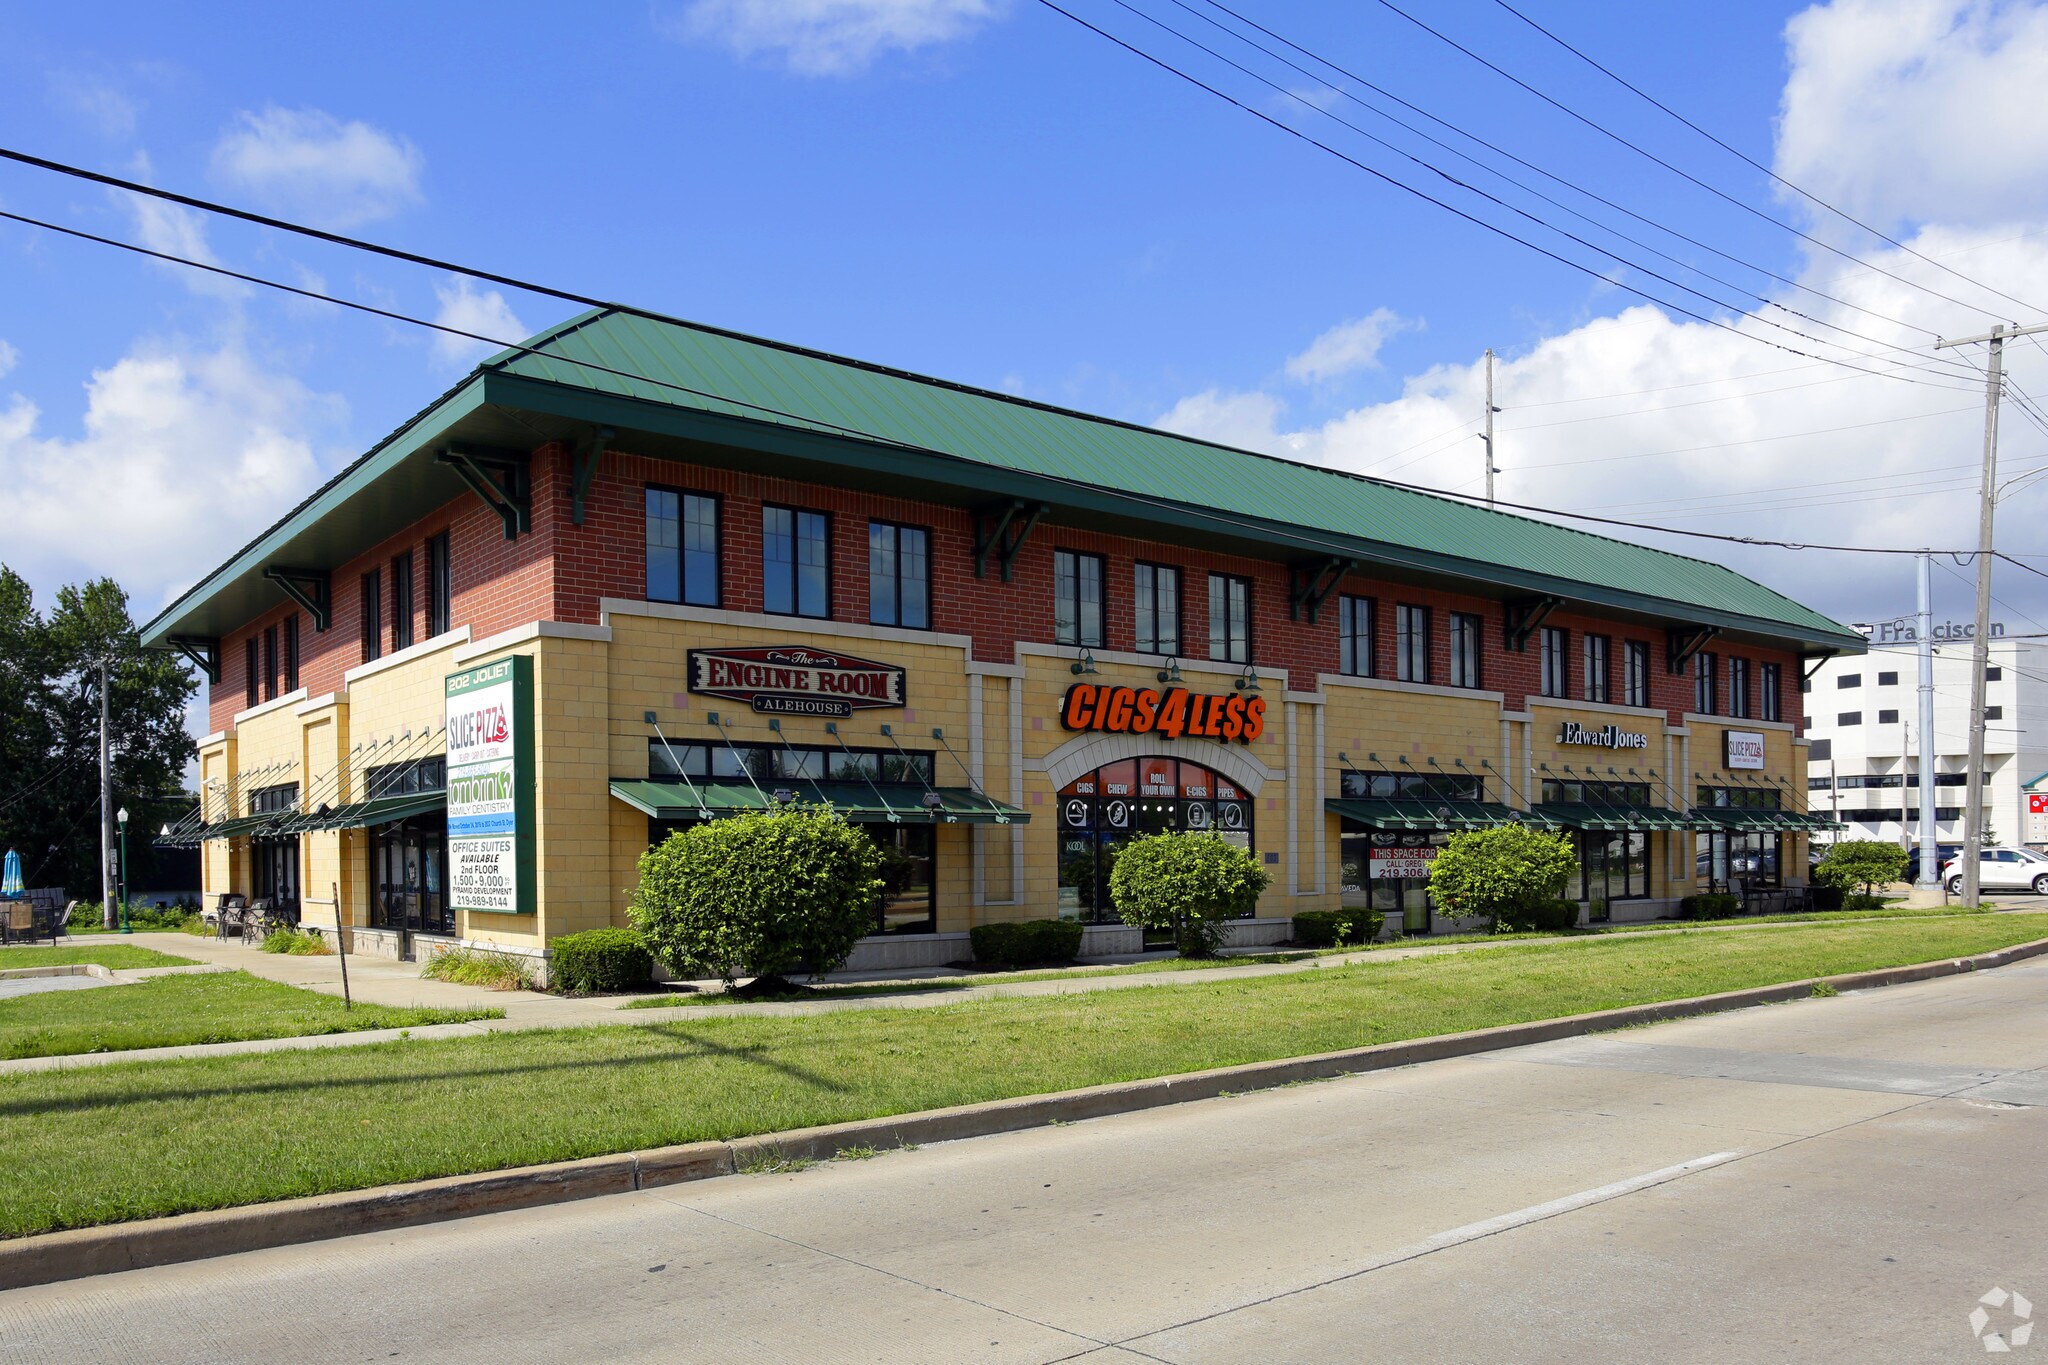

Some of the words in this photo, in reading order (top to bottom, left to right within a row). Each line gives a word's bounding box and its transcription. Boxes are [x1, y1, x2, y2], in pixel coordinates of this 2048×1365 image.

[1880, 621, 2005, 641] Fraciscn
[791, 652, 814, 665] The
[449, 675, 469, 691] 202
[473, 661, 510, 684] JOLIET
[707, 658, 809, 690] ENGINE
[817, 671, 889, 699] ROOM
[764, 699, 843, 714] ALEHOUSE
[450, 712, 474, 750] SLICE
[1565, 722, 1611, 746] Edward
[1614, 726, 1648, 749] Jones
[1729, 741, 1744, 756] SLICE
[1150, 773, 1166, 784] ROLL
[1076, 782, 1094, 794] CIGS
[1107, 783, 1128, 795] CHEW
[1141, 784, 1159, 795] YOUR
[1160, 785, 1175, 796] OWN
[1186, 786, 1207, 797] E-CIGS
[1218, 787, 1235, 798] PIPES
[450, 806, 470, 816] FAMILY
[472, 801, 510, 814] DENTISTRY
[452, 842, 478, 853] OFFICE
[480, 840, 511, 852] SUITES
[1066, 841, 1085, 852] KOOL
[460, 854, 499, 863] AVAILABLE
[1374, 848, 1391, 859] THIS
[1393, 848, 1419, 859] SPACE
[1420, 848, 1436, 859] FOR
[461, 865, 473, 874] 2nd
[475, 865, 499, 874] FLOOR
[1386, 860, 1404, 868] CALL:
[1405, 860, 1422, 868] GREG
[454, 875, 474, 886] 1,500
[479, 875, 503, 887] 9,000
[453, 886, 473, 894] PYRAMID
[474, 887, 512, 895] DEVELOPMENT
[457, 895, 508, 907] 219-989-8144
